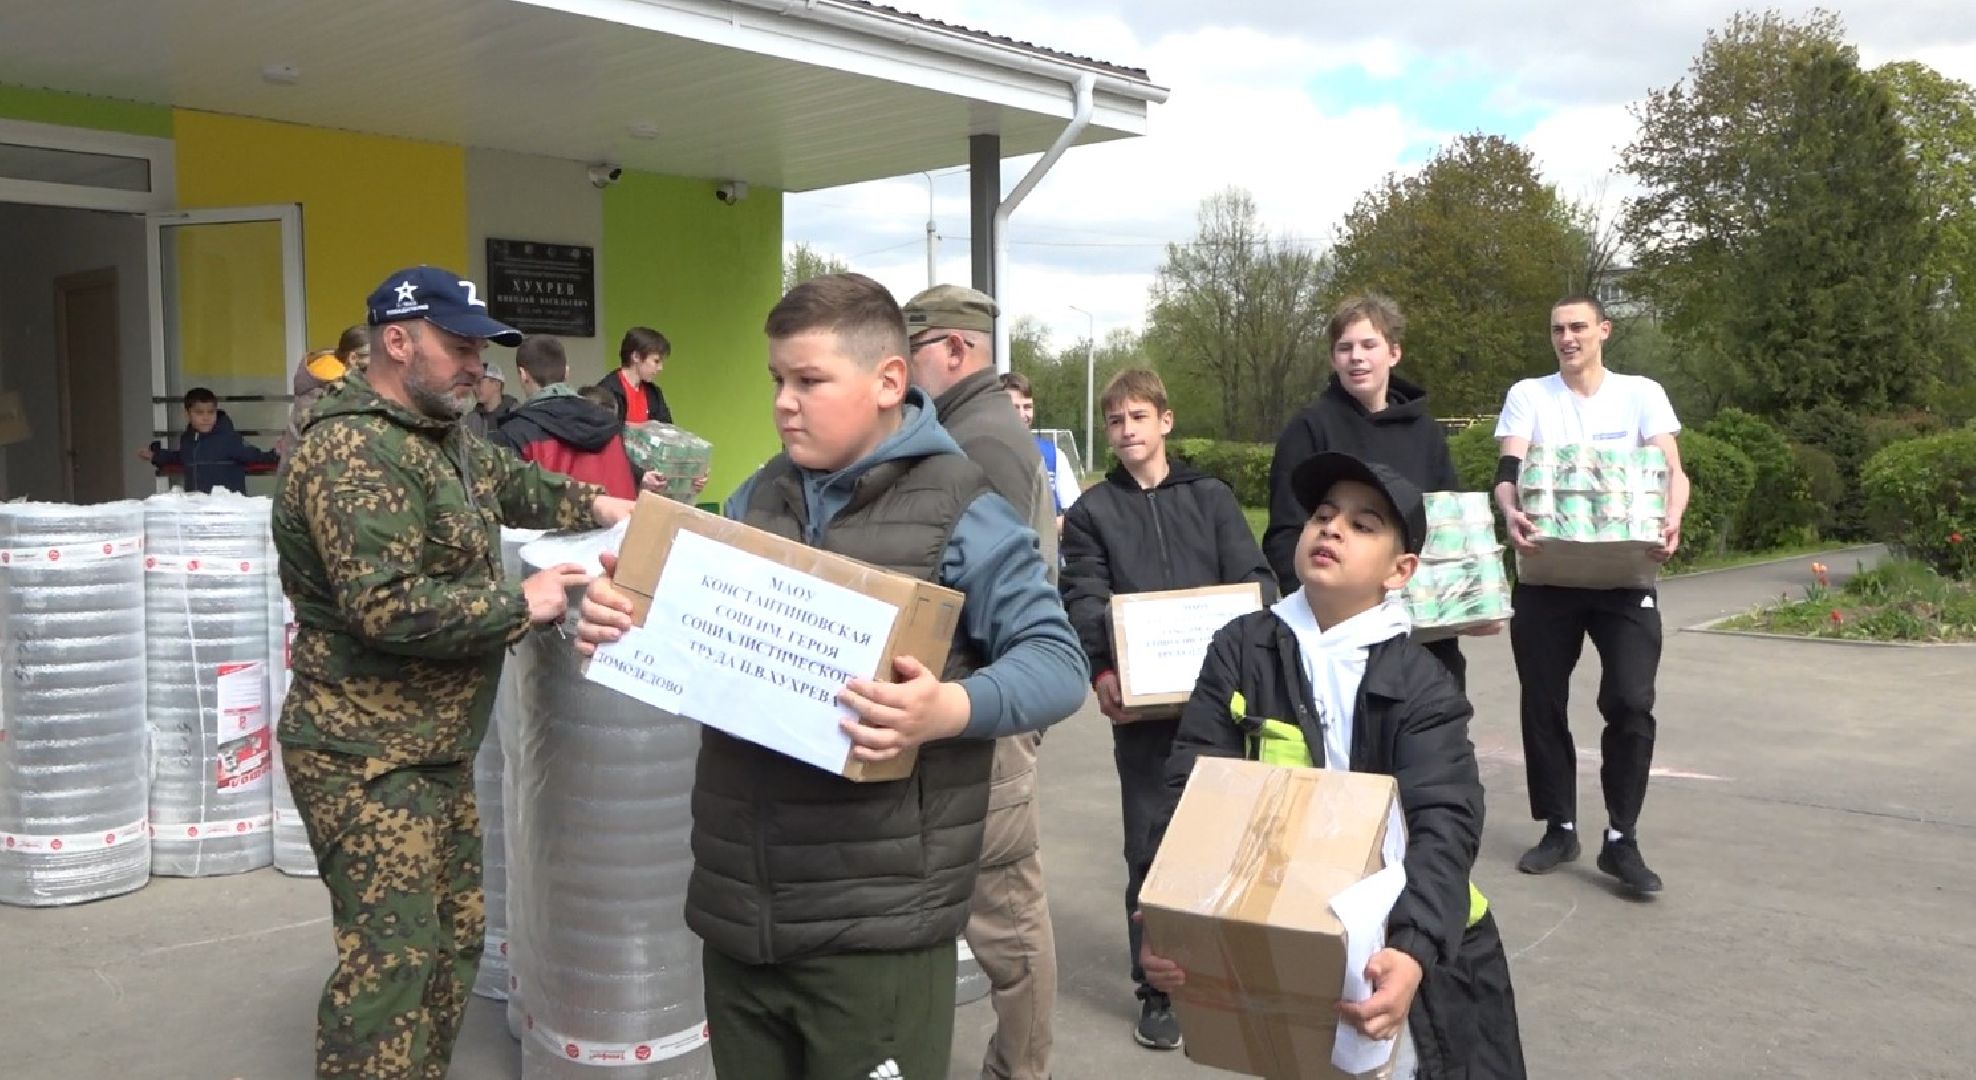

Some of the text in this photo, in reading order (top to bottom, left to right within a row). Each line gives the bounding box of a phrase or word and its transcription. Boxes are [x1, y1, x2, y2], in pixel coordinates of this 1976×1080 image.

[457, 280, 486, 307] Z
[512, 279, 575, 296] ХУХРЕВ
[769, 575, 815, 602] МАОУ
[701, 573, 872, 647] КОНСТАНТИНОВСКАЯ
[715, 603, 753, 628] СОШ
[788, 629, 839, 660] ГЕРОЯ
[681, 612, 857, 685] СОЦИАЛИСТИЧЕСКОГ
[689, 638, 735, 669] ТРУДА
